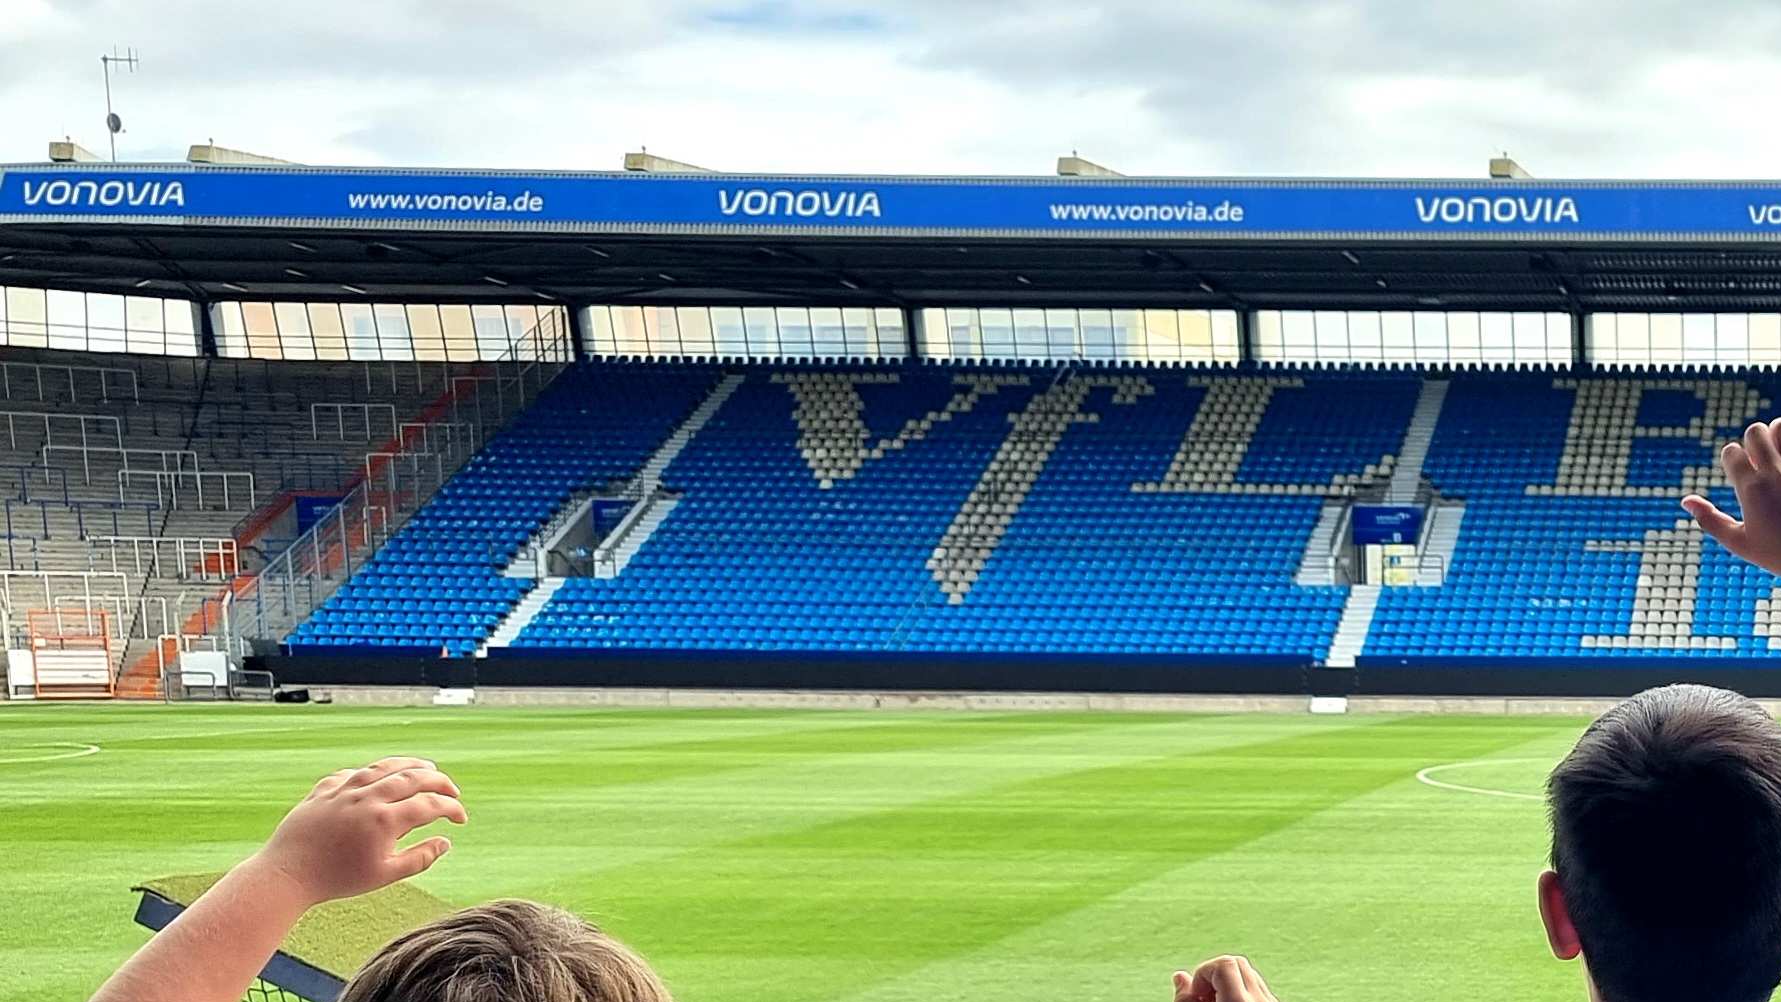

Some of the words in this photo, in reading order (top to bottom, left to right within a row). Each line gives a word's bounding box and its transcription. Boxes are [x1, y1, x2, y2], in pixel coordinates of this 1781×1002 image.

[348, 191, 543, 213] www.vonovia.de
[1050, 201, 1244, 222] www.vonovia.de
[770, 374, 1397, 604] VfL
